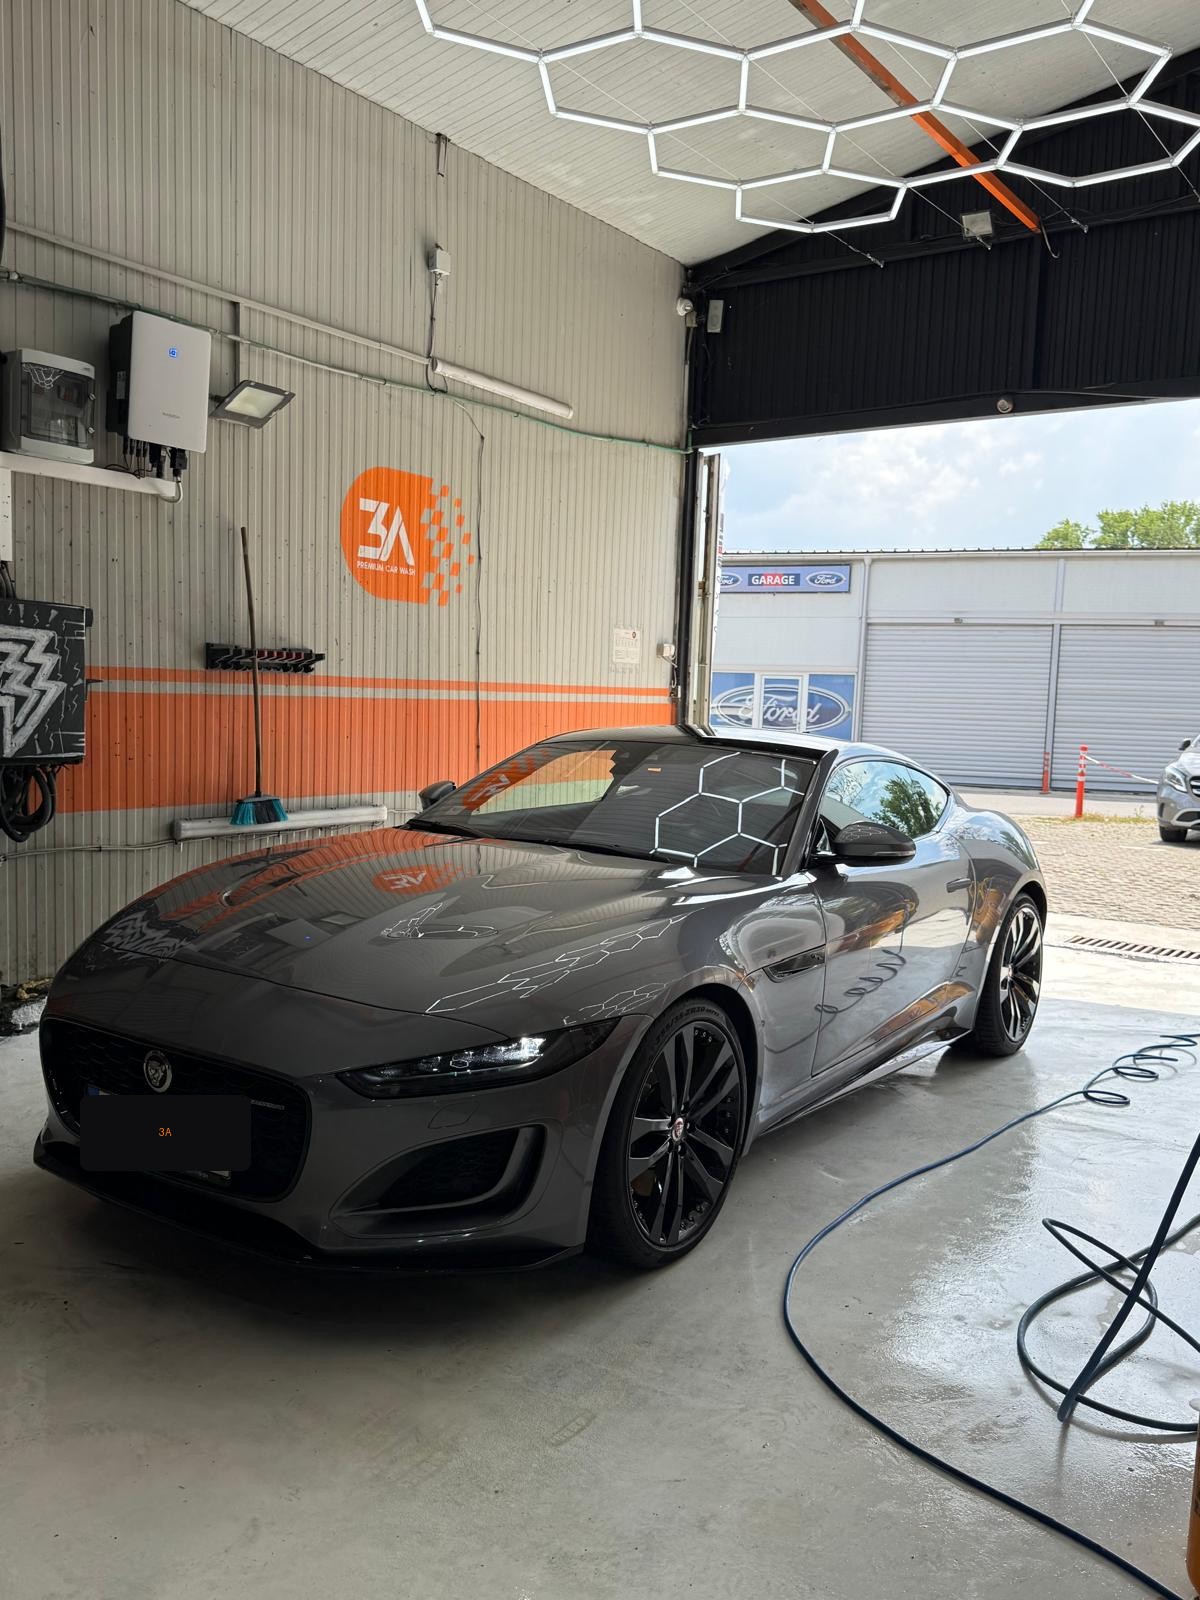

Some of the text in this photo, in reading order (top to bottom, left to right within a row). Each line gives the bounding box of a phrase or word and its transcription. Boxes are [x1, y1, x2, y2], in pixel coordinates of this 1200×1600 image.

[356, 560, 416, 576] PREMIUM CAR WASH
[751, 575, 795, 585] GARAGE
[814, 574, 837, 584] Ford
